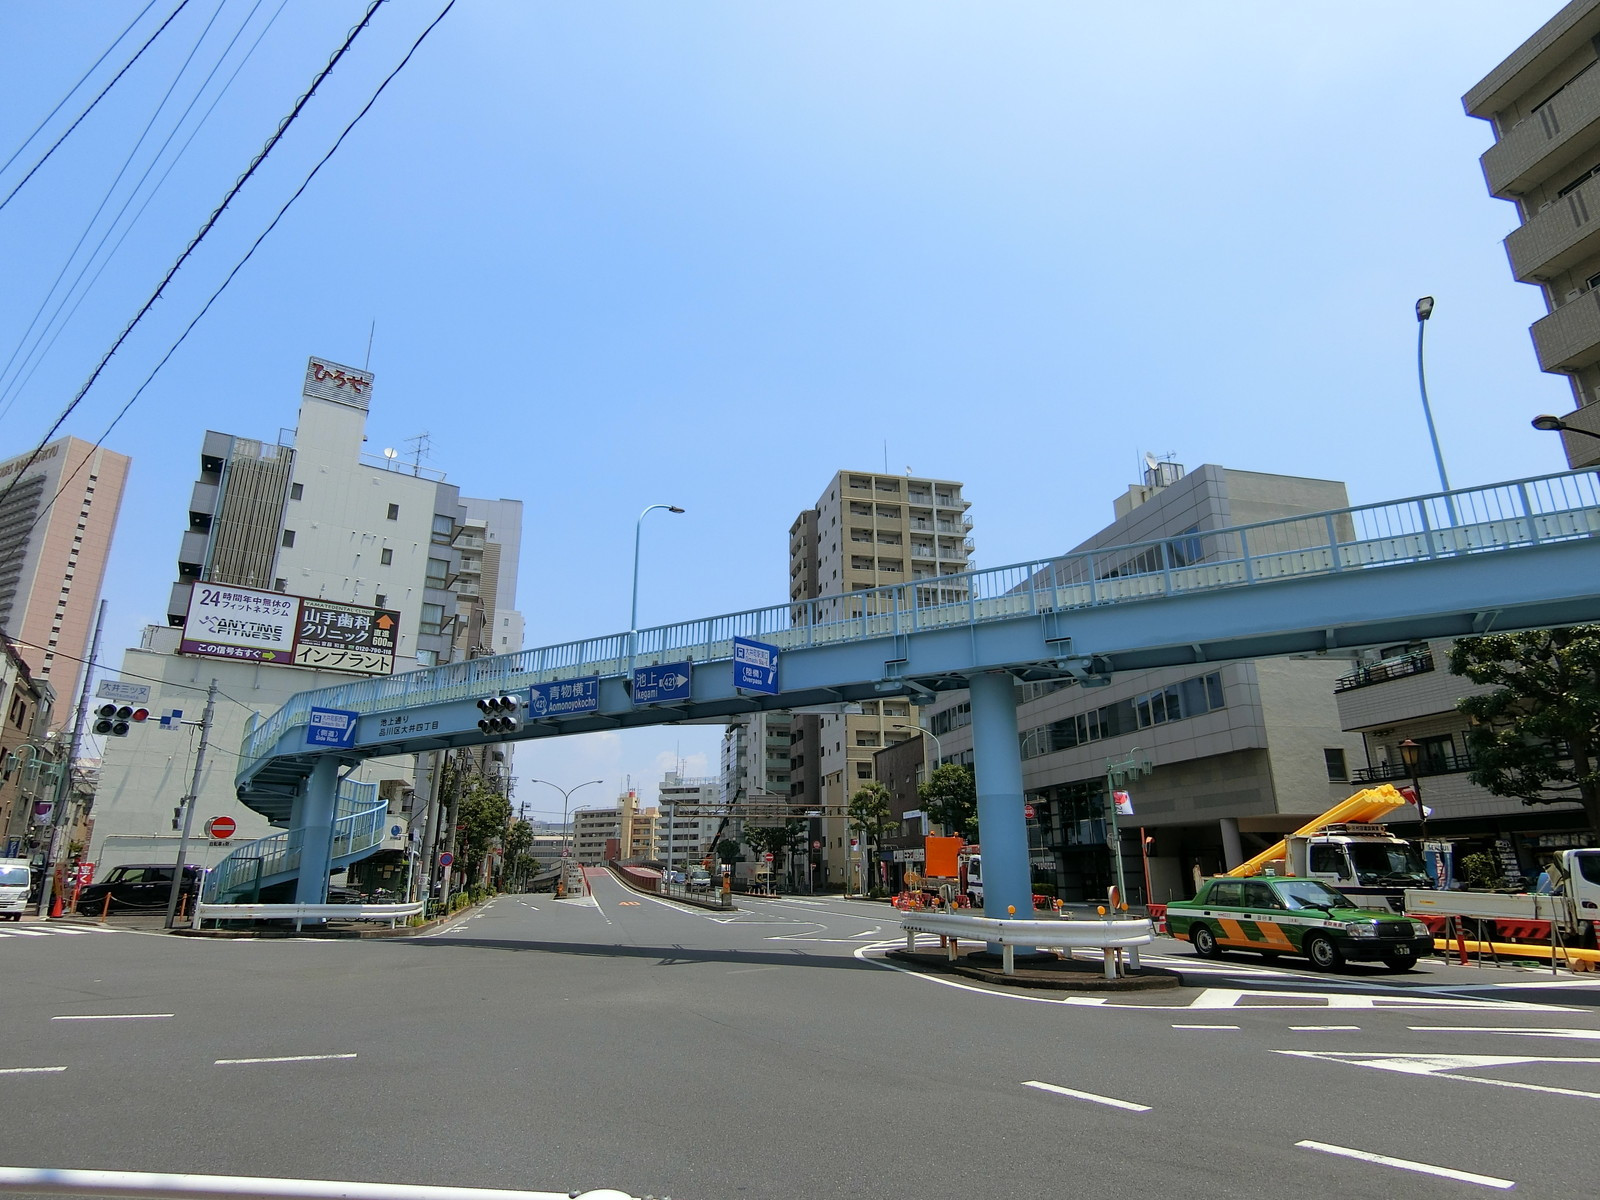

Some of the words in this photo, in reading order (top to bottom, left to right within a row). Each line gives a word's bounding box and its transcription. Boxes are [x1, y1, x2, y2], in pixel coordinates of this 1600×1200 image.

[312, 362, 370, 394] ひろせ
[200, 589, 221, 607] 24
[222, 592, 291, 609] 時間年中無休の
[222, 601, 289, 617] フィットネスジム
[217, 618, 283, 634] ANYTIME
[303, 608, 371, 631] 山手歯科
[217, 627, 282, 642] FITNESS
[301, 622, 370, 643] クリニック
[198, 643, 261, 658] この信号右すぐ
[297, 647, 390, 672] インプラント
[636, 672, 657, 689] 池上
[664, 677, 676, 687] 421
[102, 683, 147, 696] 大井三ツ又
[549, 680, 597, 700] 青物横丁
[635, 686, 658, 700] Ikegami
[535, 700, 546, 709] 421
[548, 698, 596, 712] Aomonoyokocho
[379, 720, 440, 737] 品川区大井四丁目
[380, 716, 409, 727] 池上通り
